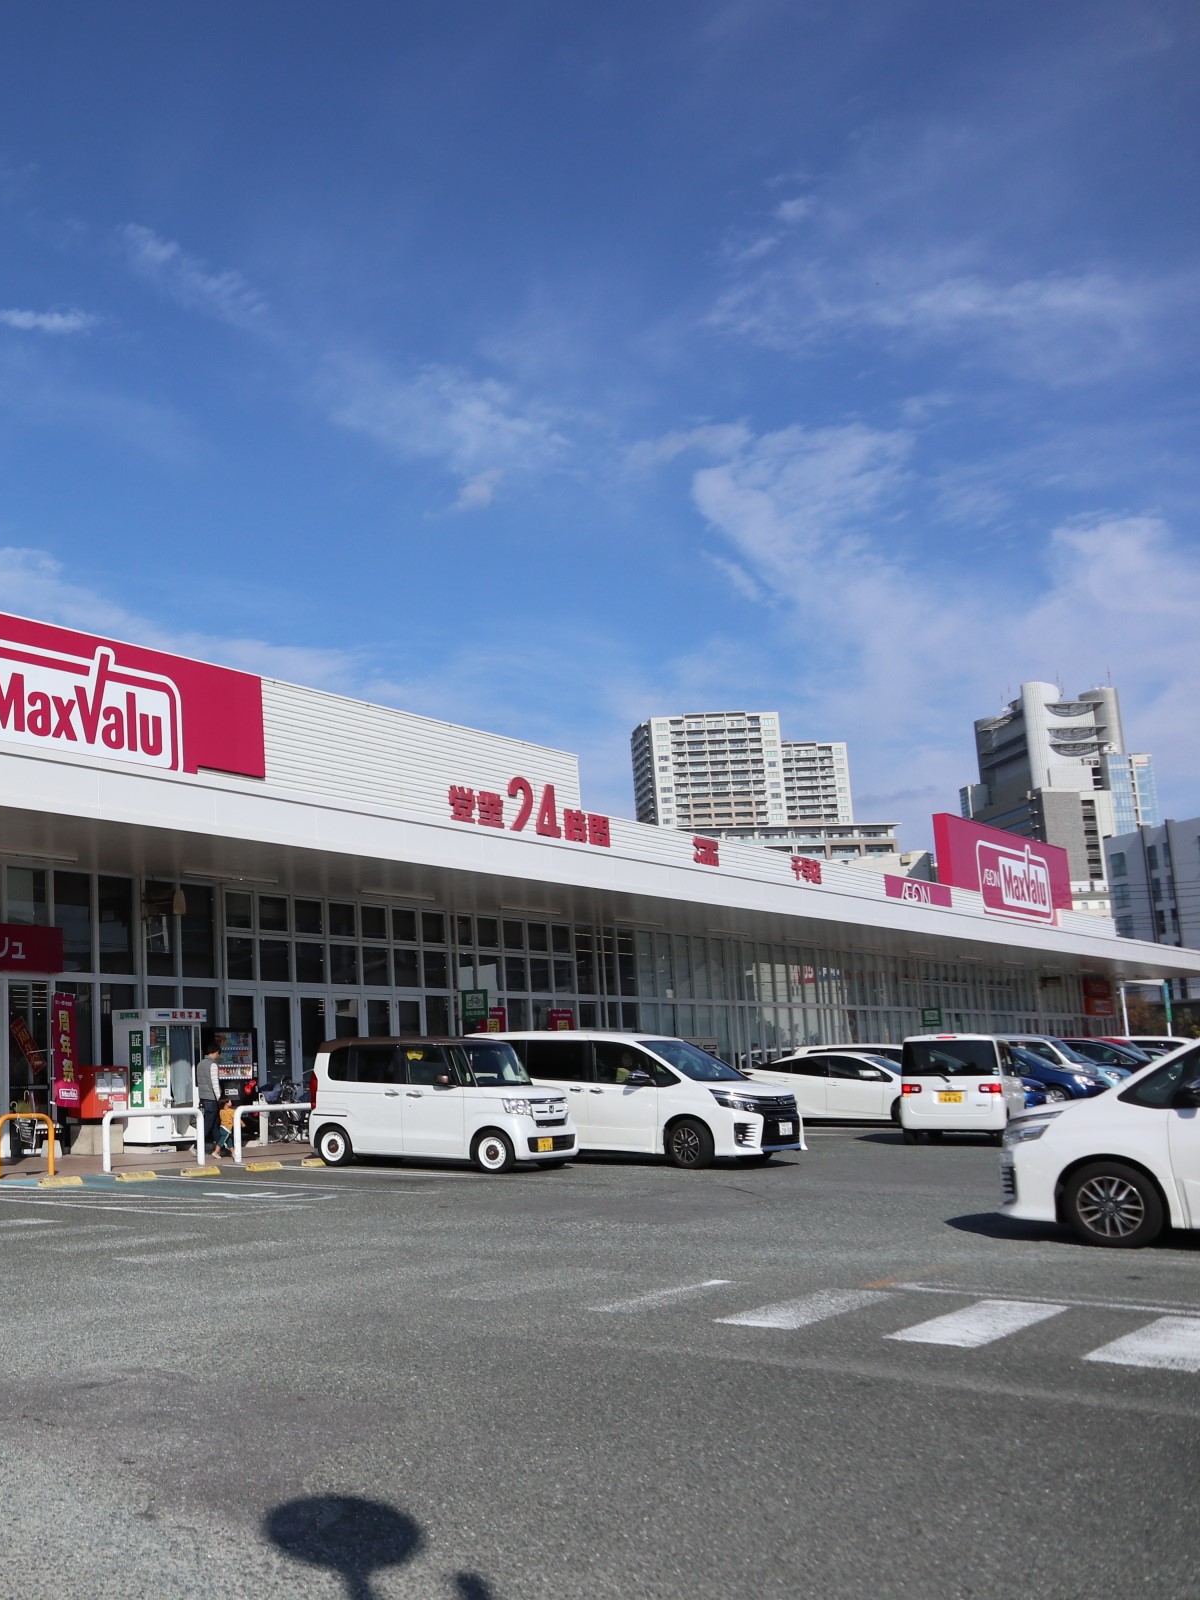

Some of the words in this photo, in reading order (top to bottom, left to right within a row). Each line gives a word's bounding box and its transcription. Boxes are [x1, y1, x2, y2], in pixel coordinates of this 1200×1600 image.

[449, 776, 611, 848] 営業24時間
[1002, 850, 1047, 907] MaxValu
[59, 1010, 75, 1083] 周年祭
[171, 1010, 201, 1020] 証明写真
[131, 1033, 142, 1104] 証明写真
